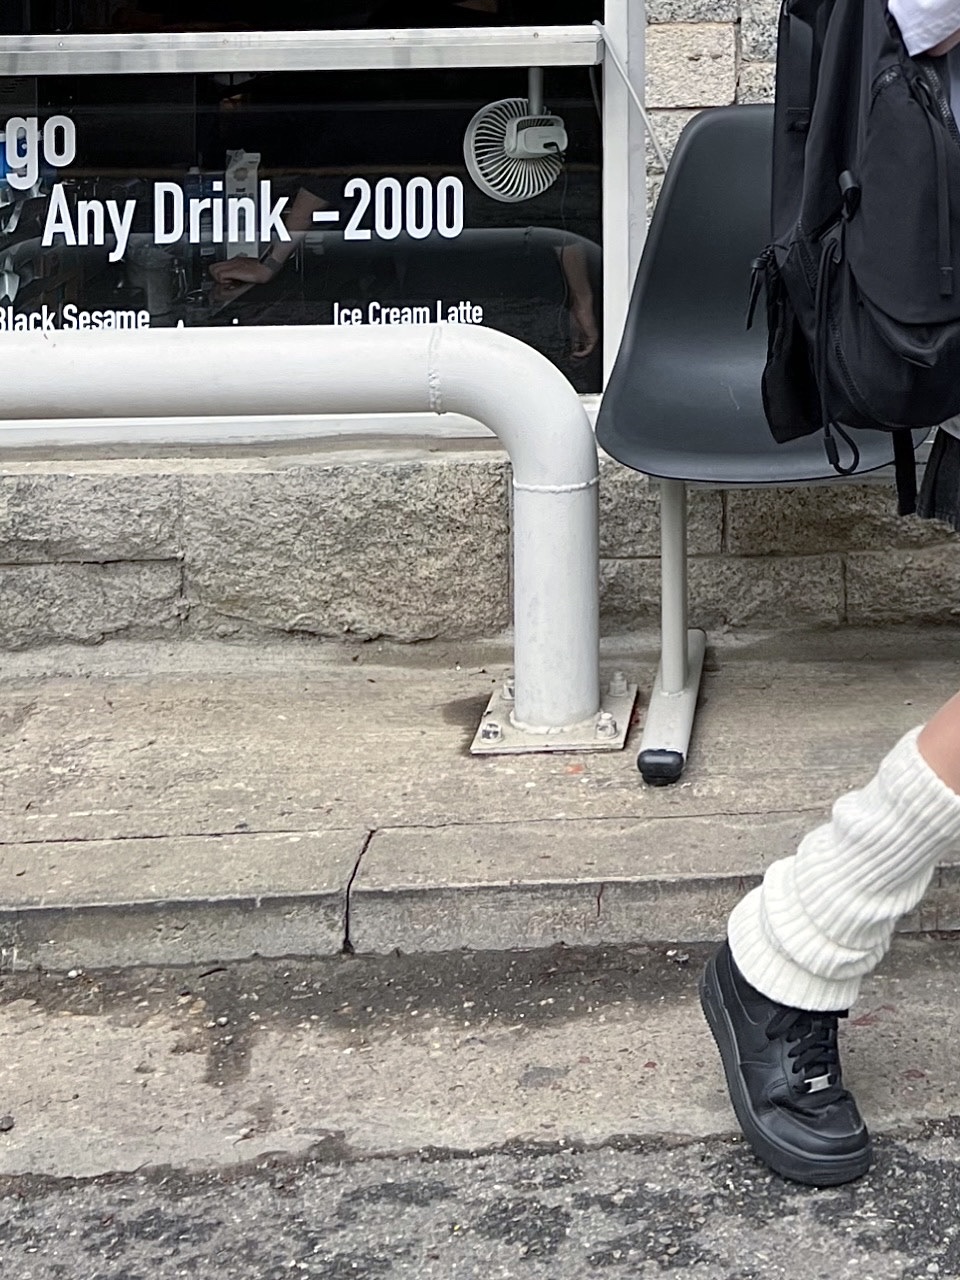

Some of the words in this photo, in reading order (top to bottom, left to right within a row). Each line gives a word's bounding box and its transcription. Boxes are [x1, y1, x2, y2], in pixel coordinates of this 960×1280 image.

[5, 114, 77, 191] go
[41, 183, 137, 262] Any
[154, 180, 292, 244] Drink
[62, 303, 151, 329] Sesame
[333, 302, 363, 325] Ice
[368, 301, 431, 325] Cream
[436, 300, 484, 323] Latte
